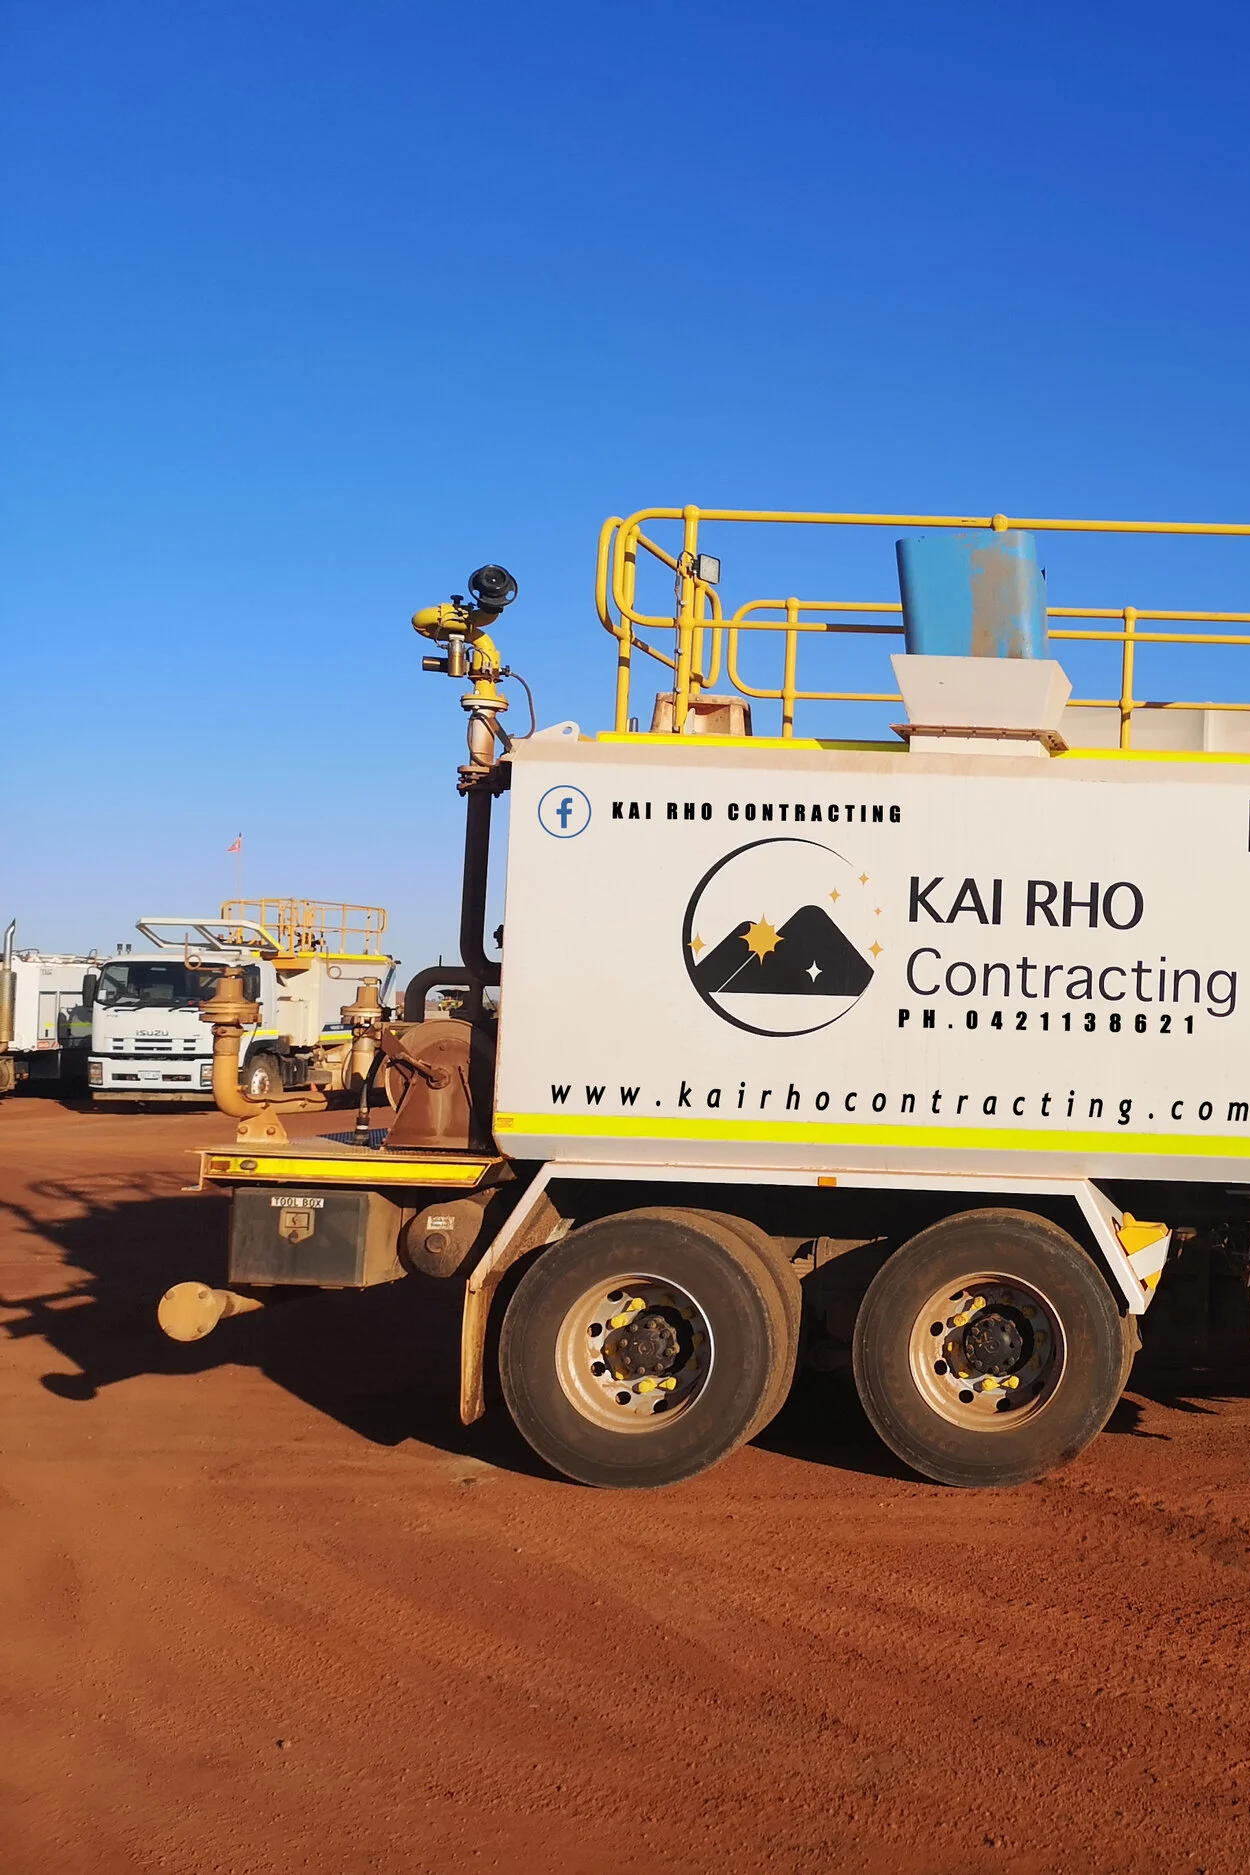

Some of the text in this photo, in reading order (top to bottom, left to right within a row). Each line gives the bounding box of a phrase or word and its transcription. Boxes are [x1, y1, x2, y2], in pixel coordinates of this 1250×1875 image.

[612, 801, 901, 823] KAI RHO CONTRACTING
[908, 876, 1144, 930] KAI RHO
[906, 947, 1238, 1018] Contracting
[136, 1029, 169, 1037] ISUZU
[274, 1197, 322, 1208] TOOL BOX
